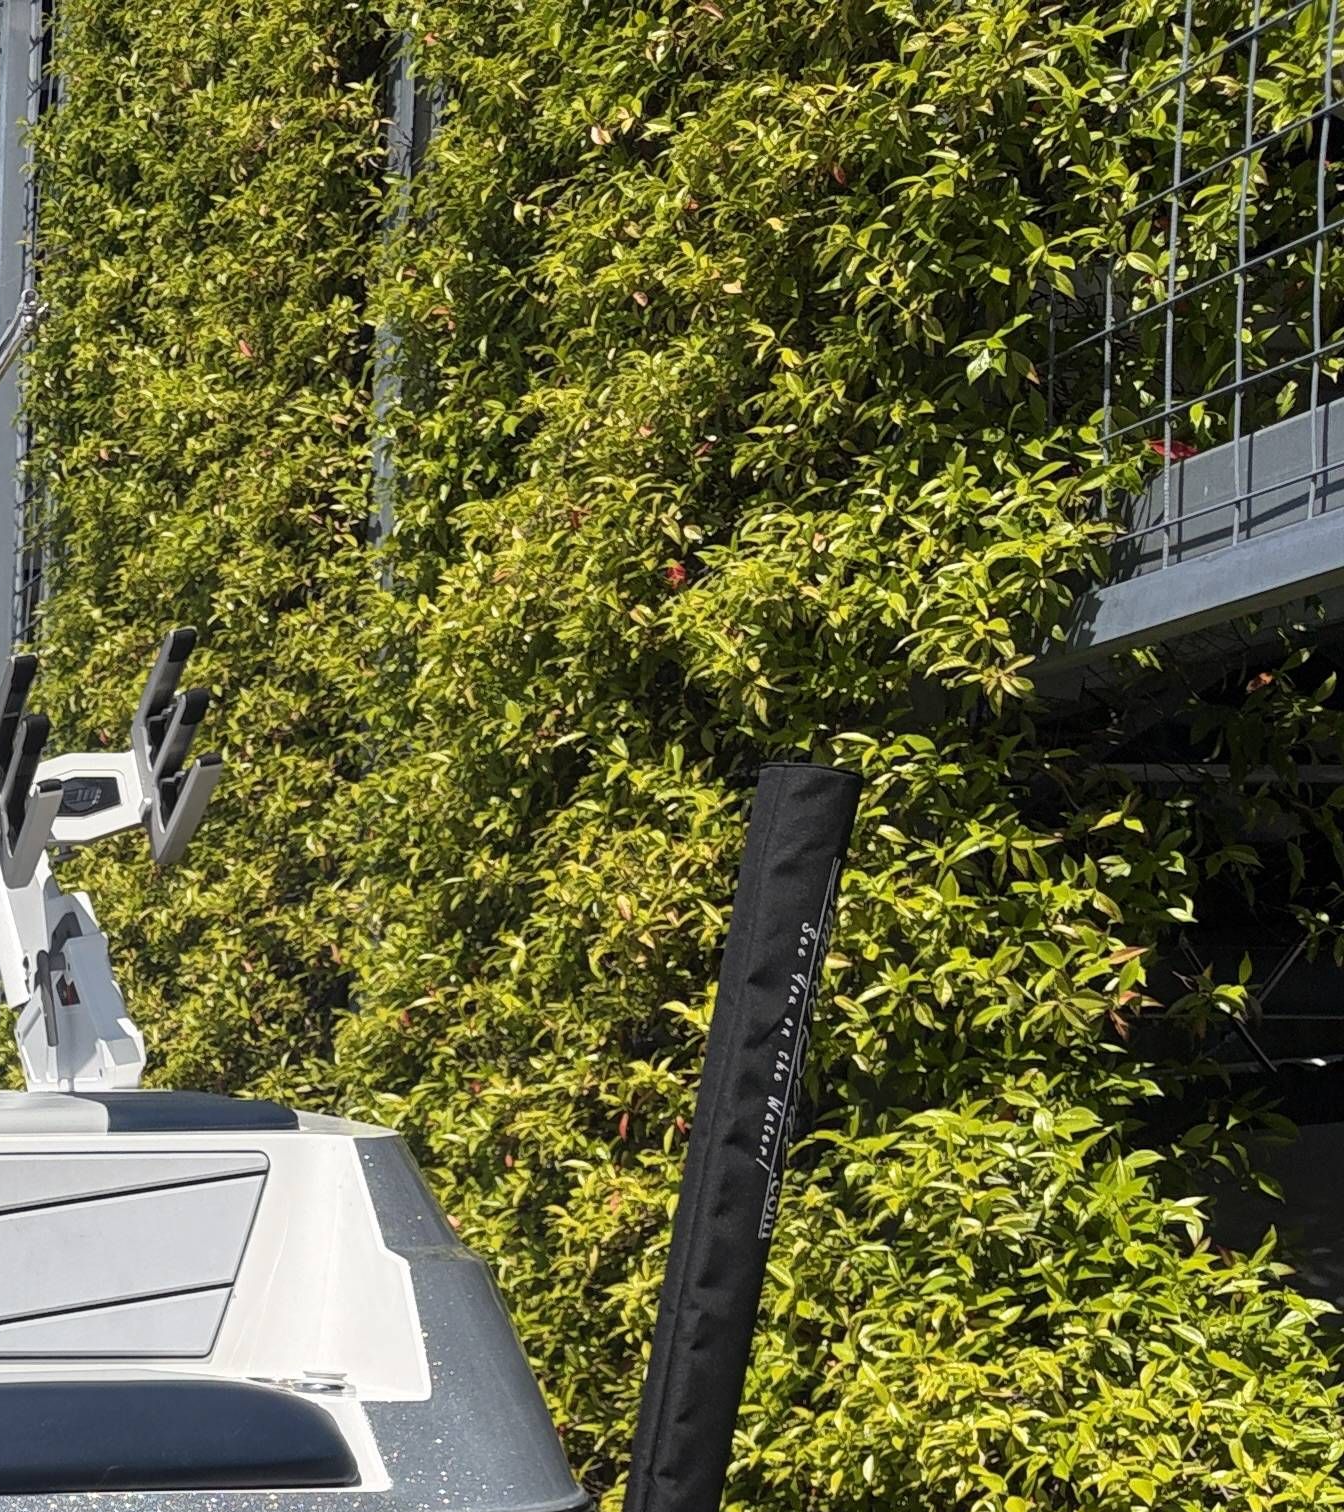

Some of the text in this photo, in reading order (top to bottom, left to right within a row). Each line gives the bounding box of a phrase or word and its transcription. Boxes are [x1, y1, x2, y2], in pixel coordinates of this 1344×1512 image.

[798, 922, 816, 957] See
[781, 1017, 794, 1037] on
[774, 1050, 790, 1082] the
